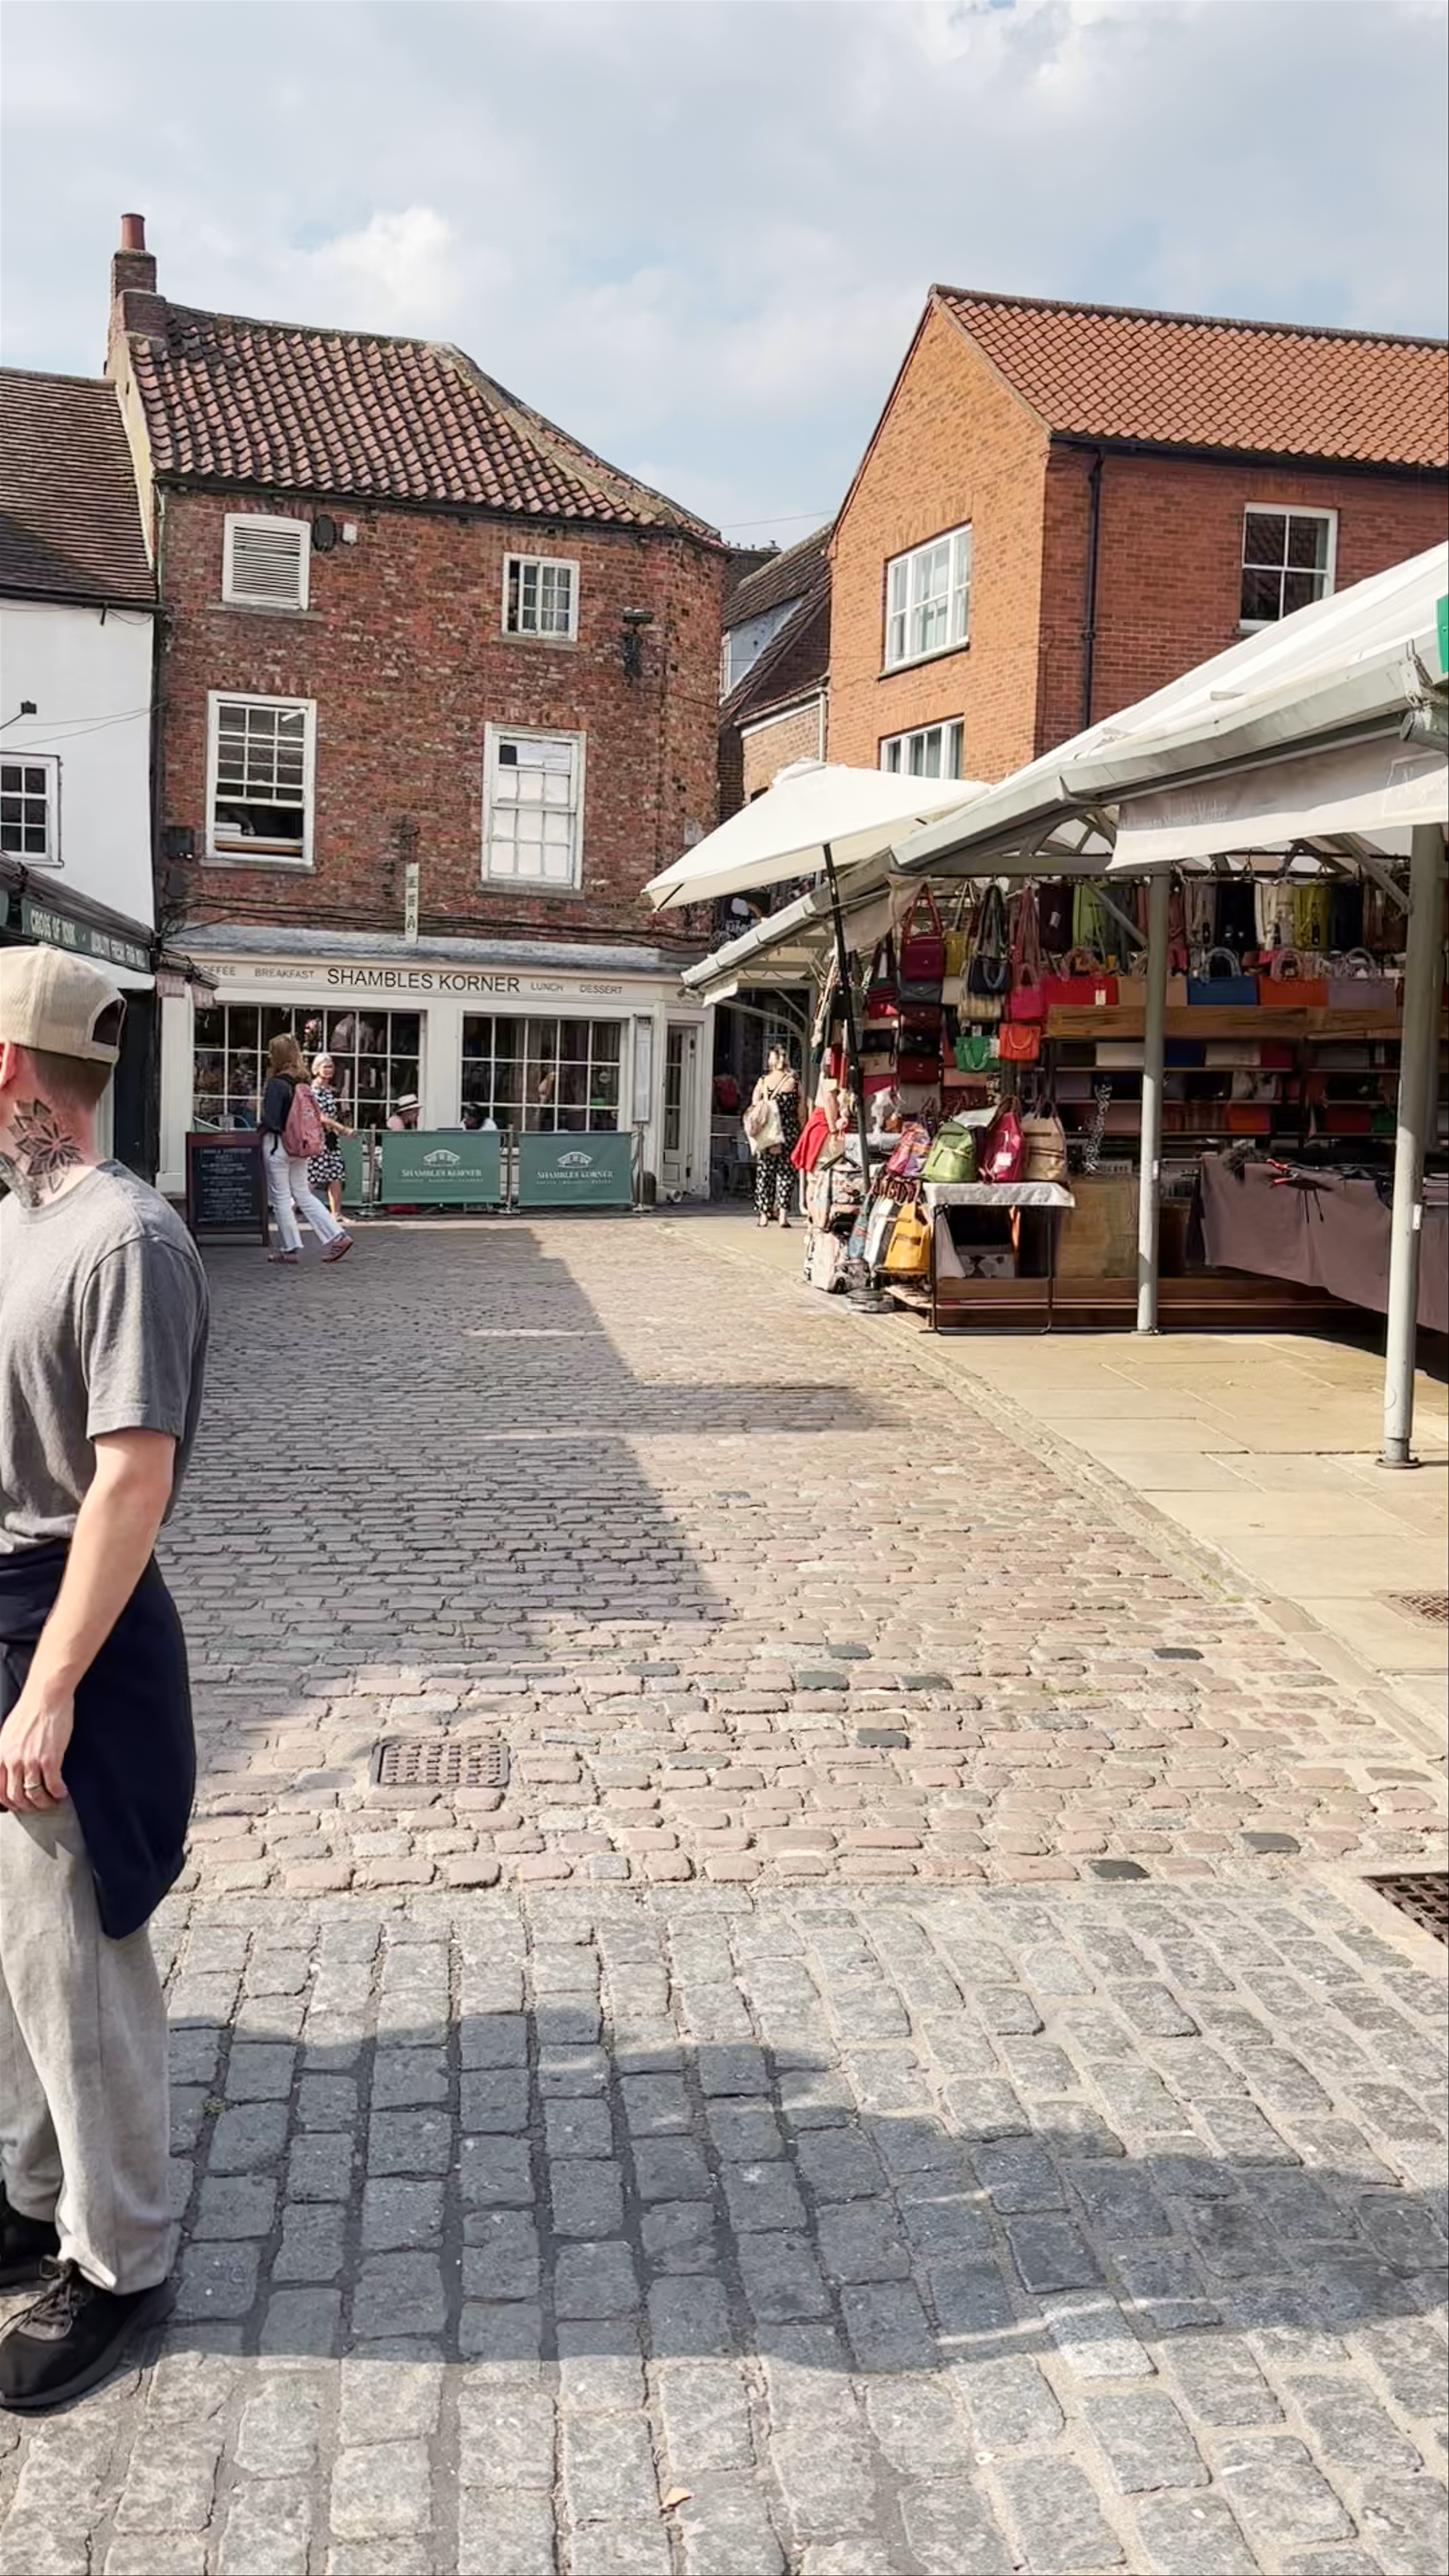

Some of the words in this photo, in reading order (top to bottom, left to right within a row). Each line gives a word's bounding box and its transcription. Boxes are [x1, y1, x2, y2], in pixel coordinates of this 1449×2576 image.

[197, 965, 236, 976] OFFEE
[254, 968, 315, 979] BREAKFAST
[327, 968, 433, 989] SHAMBLES
[439, 975, 520, 993] KORNER
[531, 983, 564, 992] LUNCH
[579, 985, 623, 994] DESSERT
